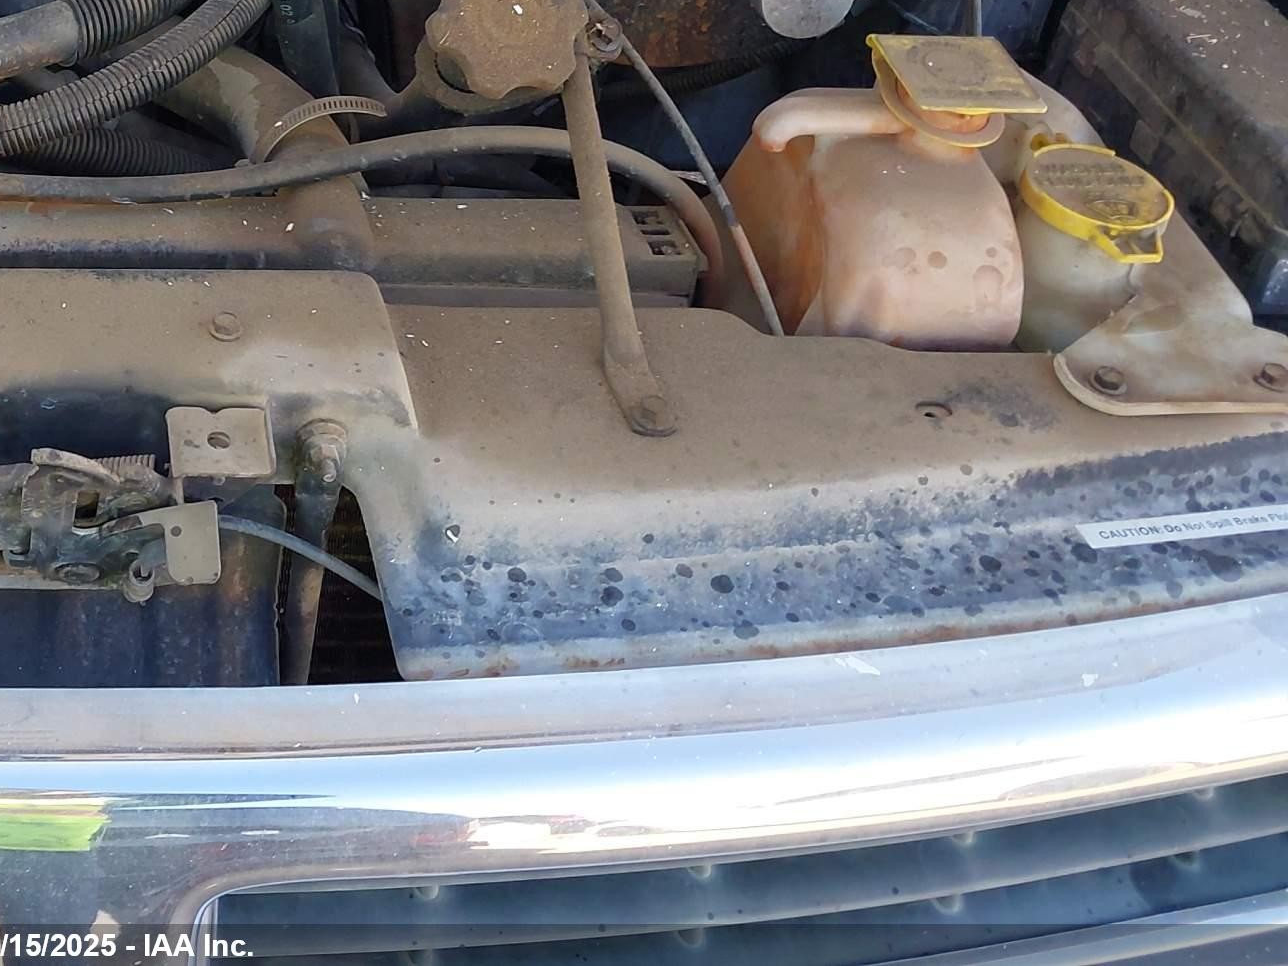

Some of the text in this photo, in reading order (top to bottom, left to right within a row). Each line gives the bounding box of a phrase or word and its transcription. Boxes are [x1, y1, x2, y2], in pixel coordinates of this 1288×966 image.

[1098, 525, 1162, 540] CAUTION:
[1164, 523, 1181, 534] Do
[1184, 522, 1206, 533] Not
[1232, 515, 1268, 528] Brake
